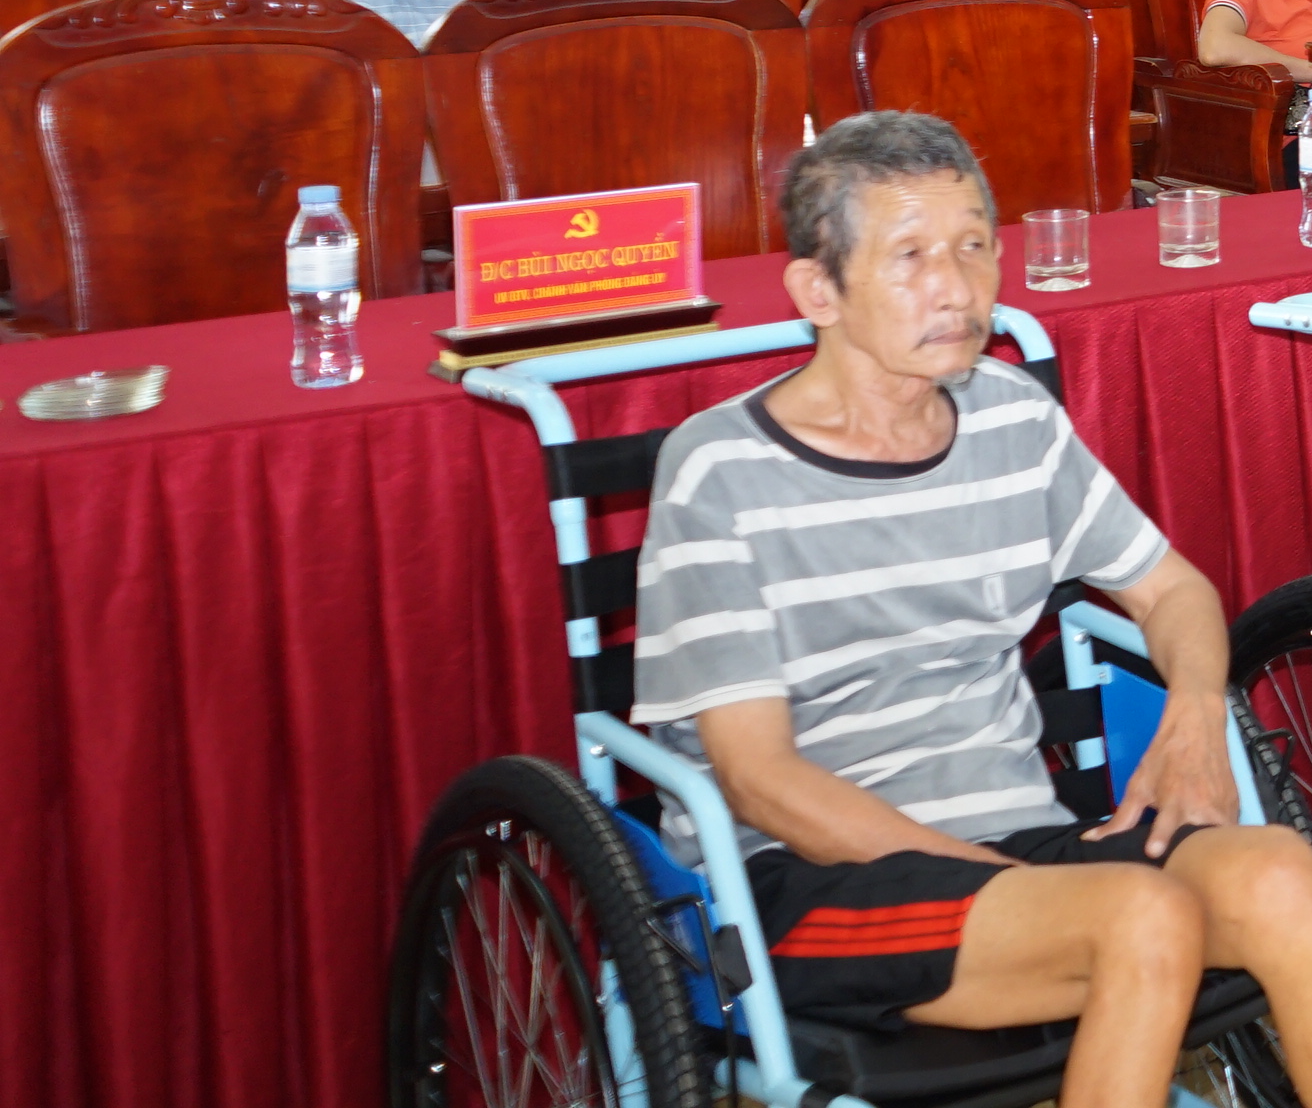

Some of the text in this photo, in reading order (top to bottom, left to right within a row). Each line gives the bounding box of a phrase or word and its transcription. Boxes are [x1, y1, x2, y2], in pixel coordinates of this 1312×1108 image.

[481, 260, 514, 283] Đ/C
[517, 251, 551, 280] BÙI
[556, 248, 610, 274] NGỌC
